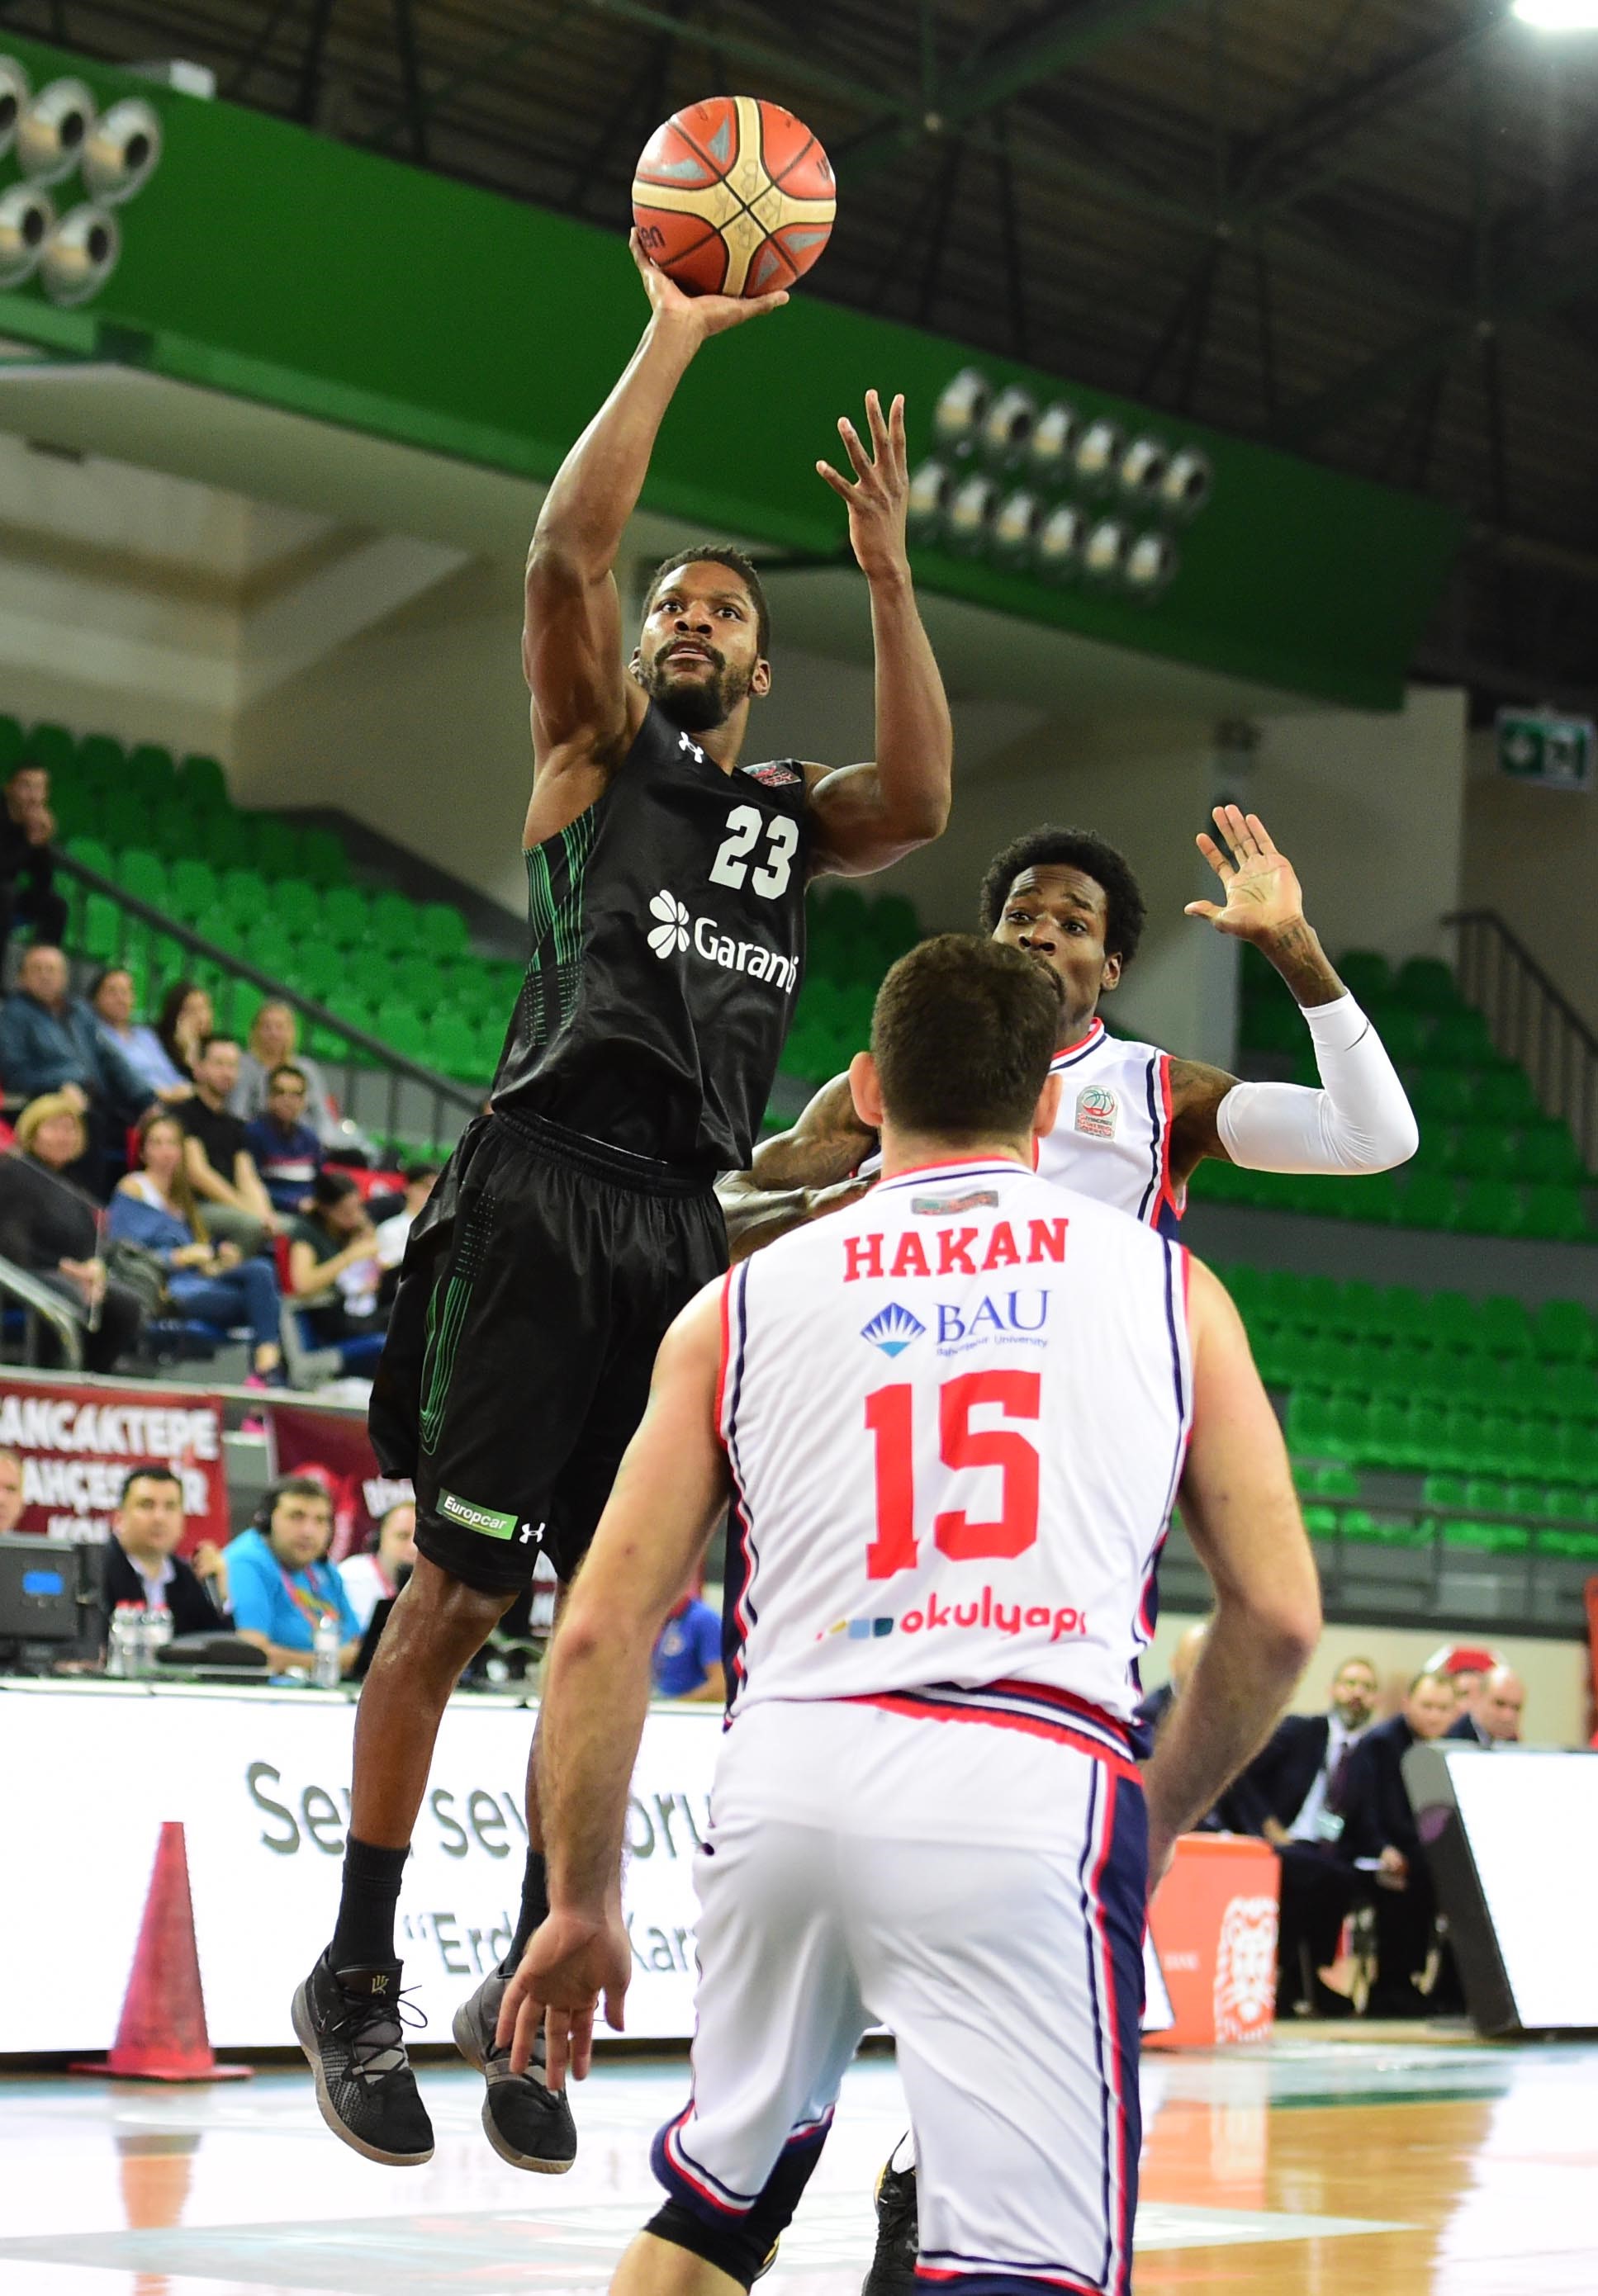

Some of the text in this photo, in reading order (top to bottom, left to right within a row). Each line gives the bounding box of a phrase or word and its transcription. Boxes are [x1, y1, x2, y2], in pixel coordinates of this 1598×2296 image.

[709, 804, 799, 901] 23
[843, 1217, 1069, 1283] HAKAN
[934, 1289, 1053, 1347] BAU
[865, 1369, 1041, 1580] 15
[443, 1495, 508, 1526] Europcar
